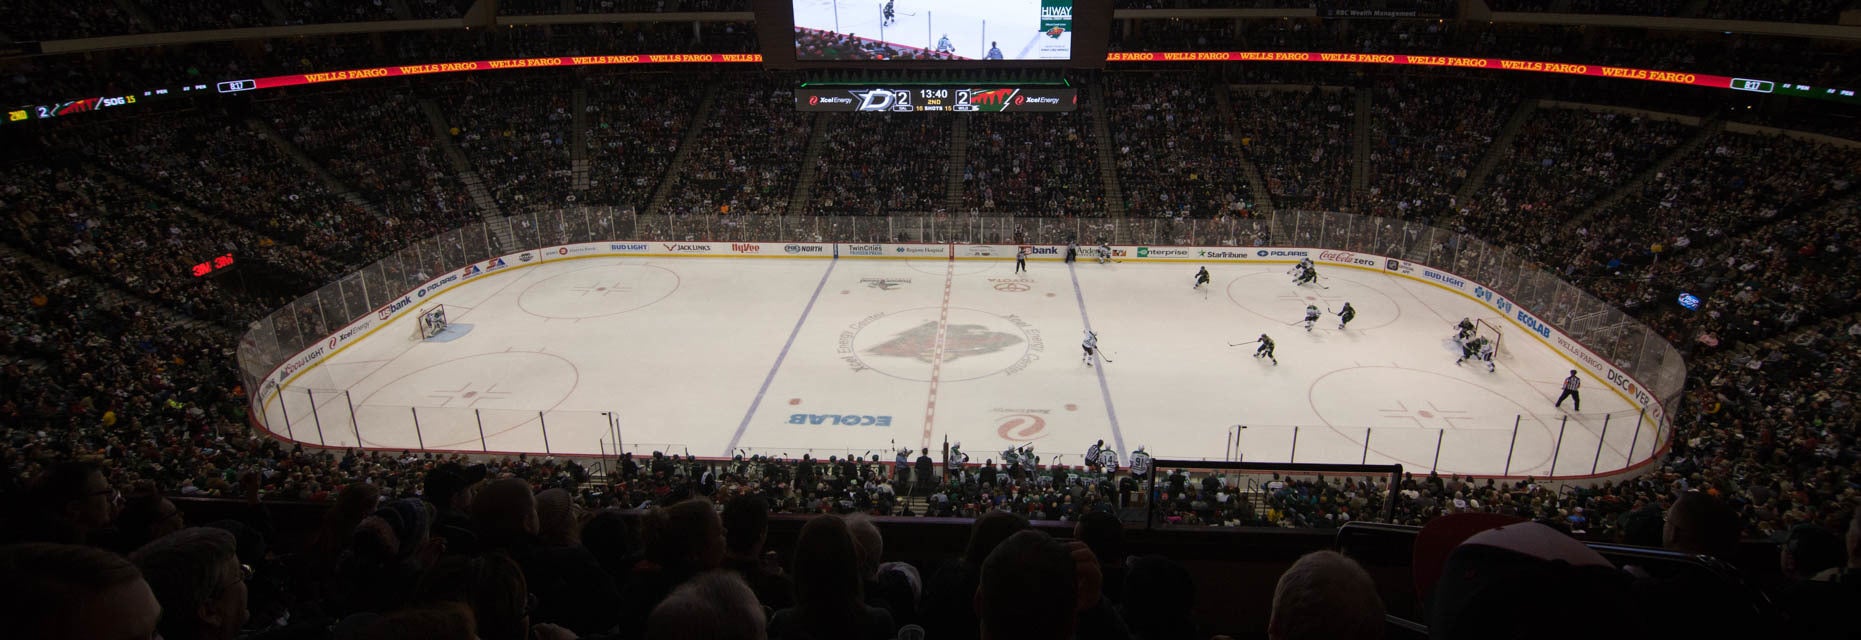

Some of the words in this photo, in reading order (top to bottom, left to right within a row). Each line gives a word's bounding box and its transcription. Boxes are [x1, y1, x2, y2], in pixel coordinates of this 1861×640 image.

[1041, 6, 1072, 16] HIWAY
[572, 57, 606, 65] WELLS
[608, 55, 639, 63] FARGO
[683, 54, 712, 62] FARGO
[722, 54, 753, 62] WELLS
[1122, 52, 1154, 61] FARGO
[1164, 52, 1197, 61] WELLS
[1198, 52, 1230, 61] FARGO
[1240, 52, 1274, 61] WELLS
[1275, 52, 1309, 61] FARGO
[1320, 53, 1357, 62] WELLS
[1358, 54, 1395, 64] FARGO
[1406, 55, 1446, 65] WELLS
[1447, 57, 1488, 68] FARGO
[400, 65, 438, 74] WELLS
[441, 62, 477, 72] FARGO
[488, 60, 526, 69] WELLS
[528, 57, 561, 67] FARGO
[1500, 60, 1543, 72] WELLS
[1544, 63, 1587, 74] FARGO
[305, 72, 346, 83] WELLS
[349, 68, 387, 79] FARGO
[1601, 67, 1647, 80] WELLS
[1649, 70, 1696, 84] FARGO
[898, 92, 908, 105] 2
[920, 89, 948, 98] 13:40
[958, 92, 968, 105] 2
[103, 97, 125, 107] SOG
[38, 107, 48, 118] 2
[1032, 246, 1058, 255] bank
[192, 260, 212, 277] 3M
[214, 253, 234, 269] 3M
[1354, 258, 1375, 266] zero
[426, 274, 458, 292] POLARIS
[1424, 270, 1442, 282] BUD
[1442, 274, 1465, 288] LIGHT
[390, 296, 412, 313] bank
[1516, 310, 1551, 339] ECOLAB
[304, 347, 325, 363] LIGHT
[1557, 337, 1579, 356] WELLS
[1579, 351, 1603, 371] FARGO
[1607, 368, 1649, 409] DISCOVER
[788, 413, 893, 427] ECOLAB
[1103, 455, 1113, 465] 14
[1135, 457, 1144, 467] 91
